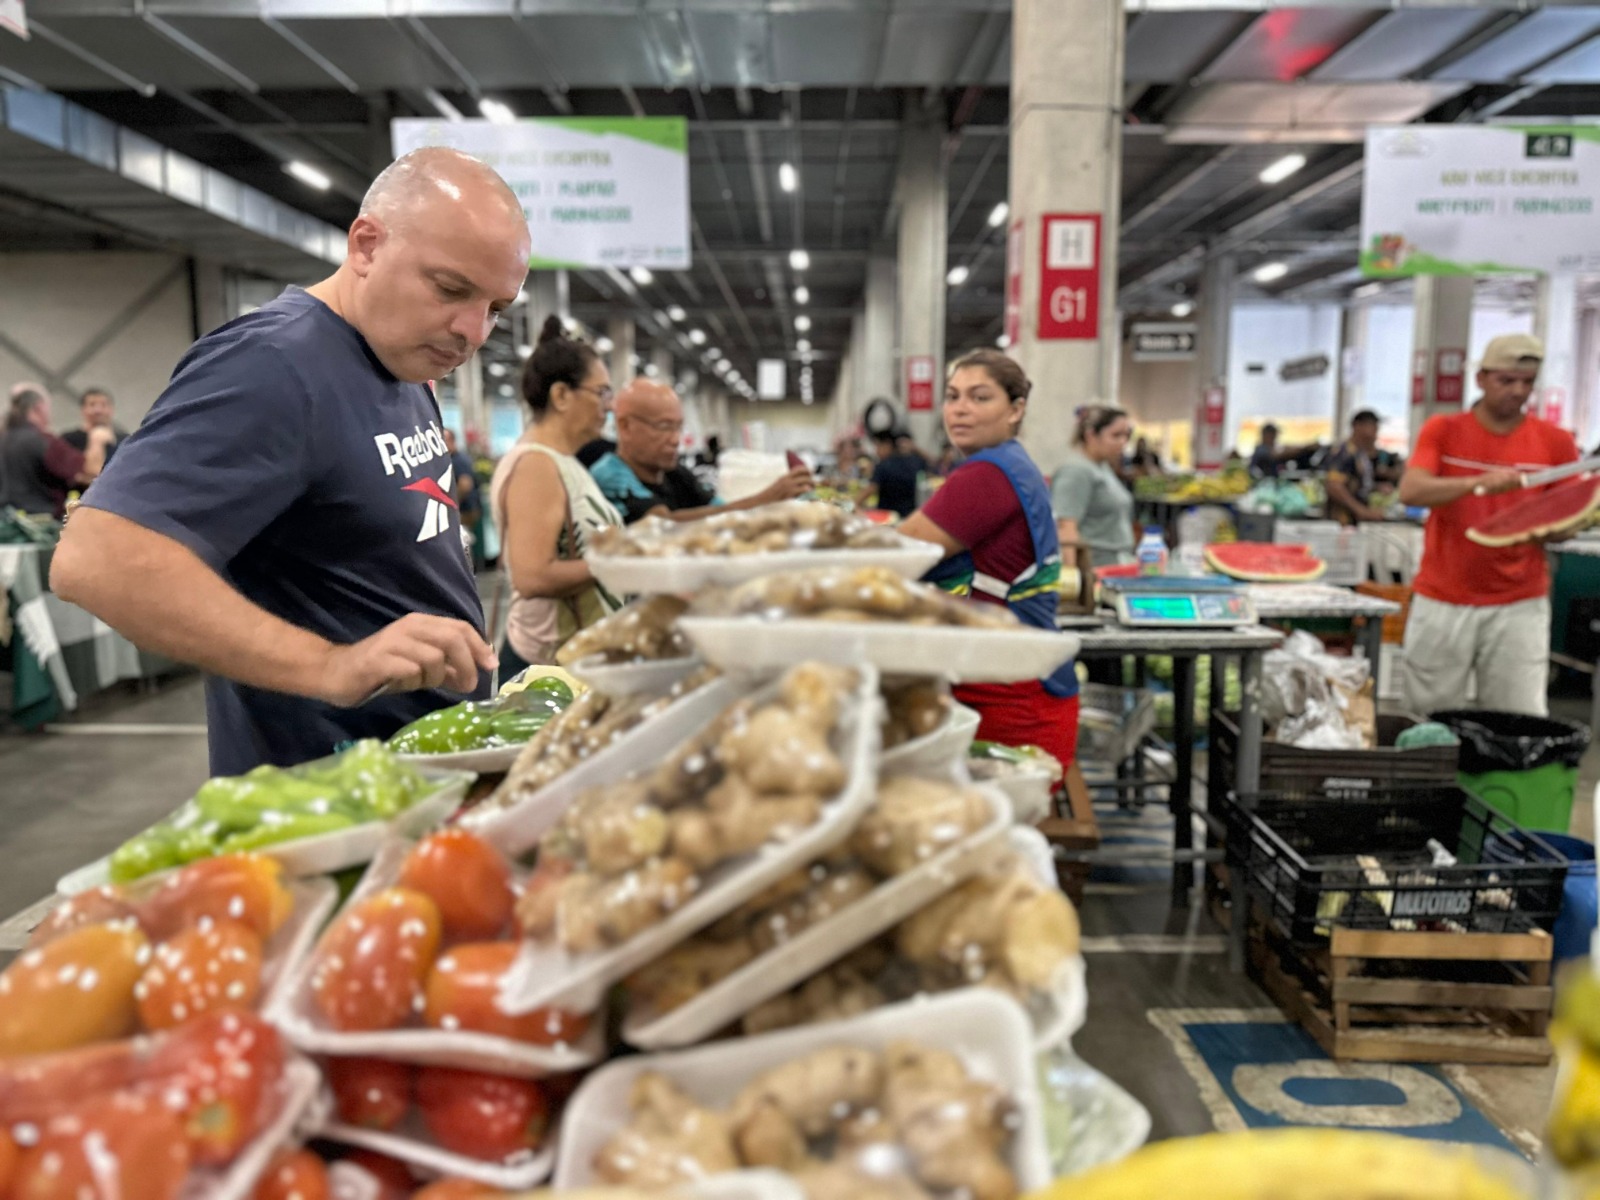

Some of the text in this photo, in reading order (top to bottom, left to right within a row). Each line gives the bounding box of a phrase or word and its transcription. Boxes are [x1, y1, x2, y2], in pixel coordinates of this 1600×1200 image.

[1060, 228, 1085, 261] H
[1050, 286, 1088, 323] G1
[374, 421, 448, 479] Reebok
